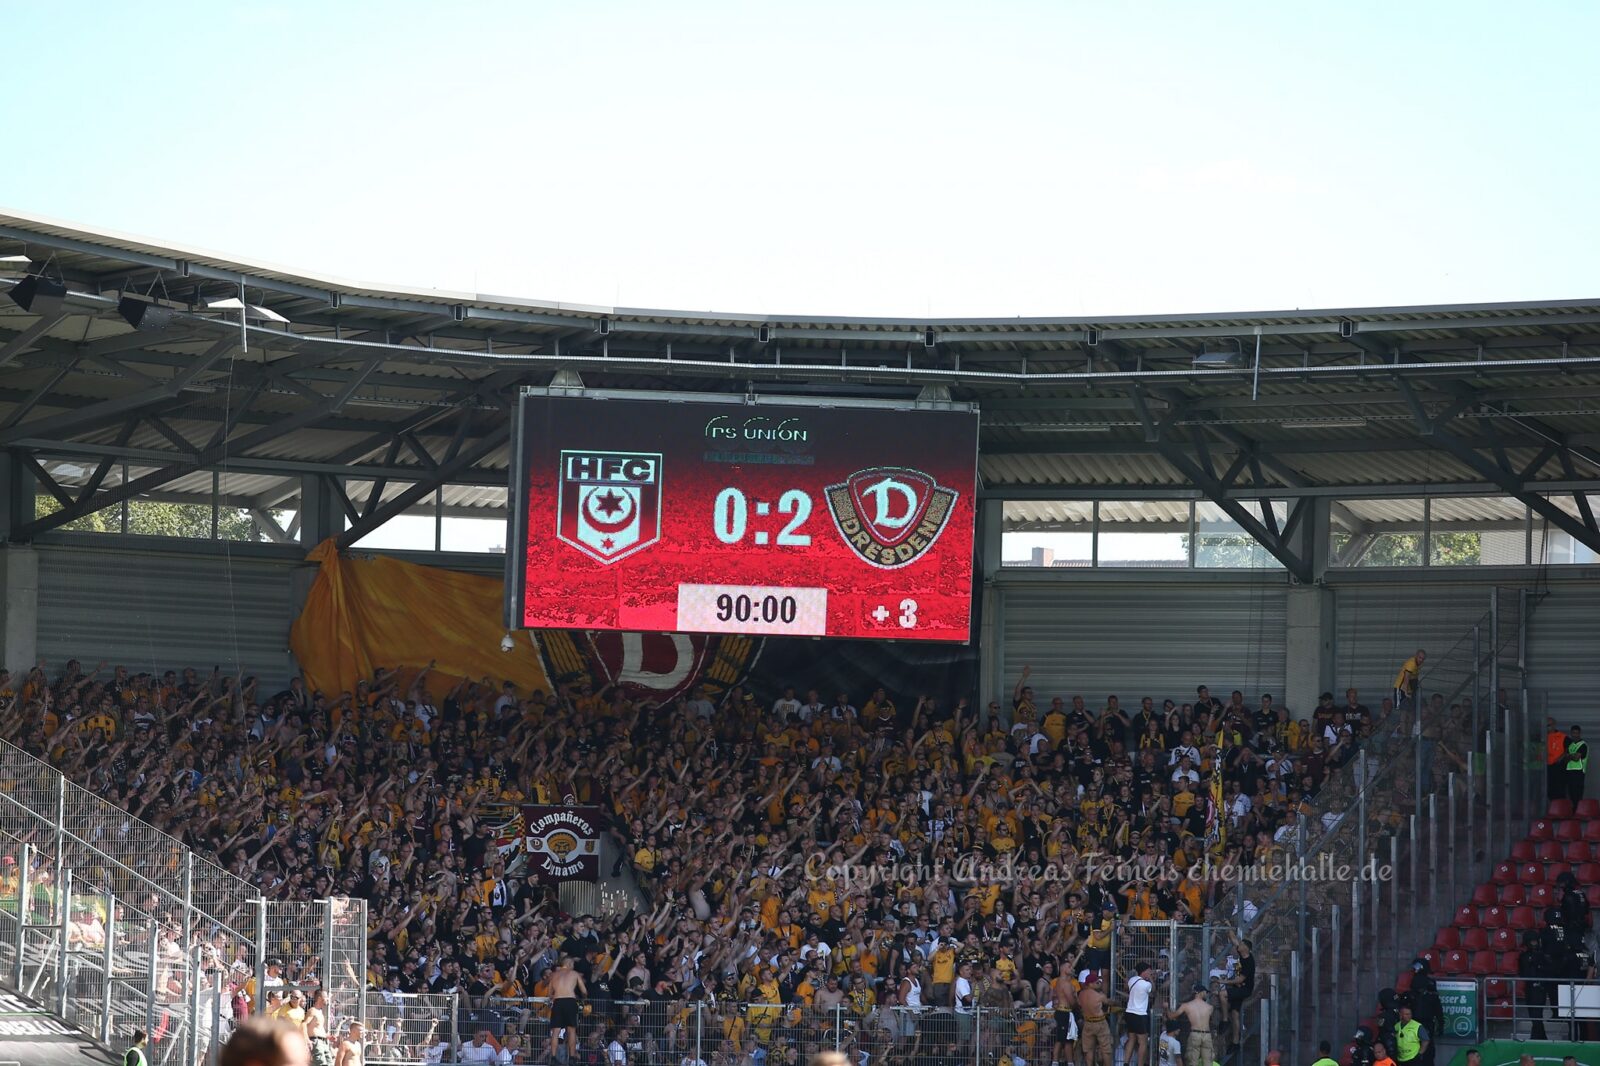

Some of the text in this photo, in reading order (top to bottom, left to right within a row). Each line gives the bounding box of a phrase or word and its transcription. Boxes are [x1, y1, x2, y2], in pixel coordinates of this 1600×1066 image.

[744, 428, 807, 441] UNION
[571, 457, 651, 483] HFC
[713, 487, 813, 546] 0:2
[861, 477, 918, 528] D
[841, 519, 940, 565] DRESDEN
[716, 593, 797, 623] 90:00
[530, 810, 594, 836] Compañeros
[541, 856, 585, 877] Dynamo
